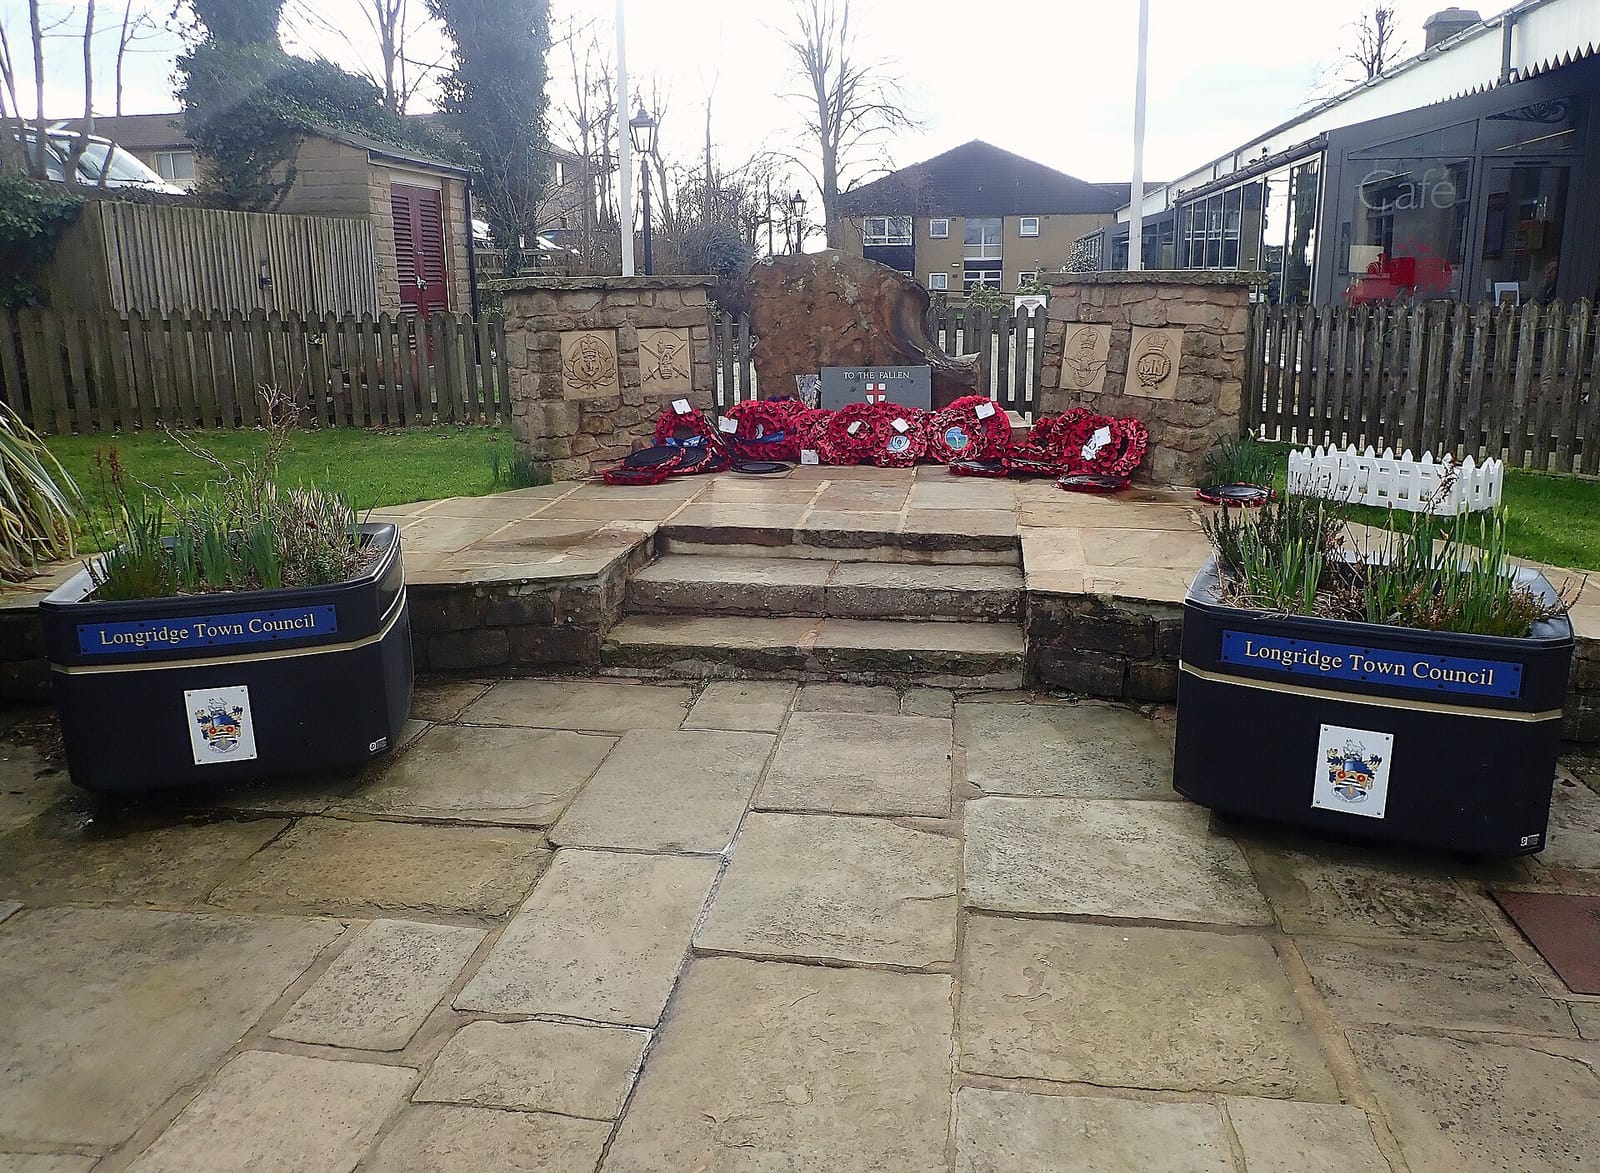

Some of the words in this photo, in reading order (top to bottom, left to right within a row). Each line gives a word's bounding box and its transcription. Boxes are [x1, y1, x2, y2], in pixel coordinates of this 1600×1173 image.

[1358, 167, 1457, 211] Café
[843, 371, 855, 380] TO
[858, 371, 875, 380] THE
[879, 371, 910, 380] FALLEN
[100, 628, 189, 647] Longridge
[193, 622, 244, 639] Town
[247, 613, 316, 635] Council
[1245, 641, 1342, 671] Longridge
[1349, 654, 1406, 677] Town
[1412, 661, 1495, 686] Council
